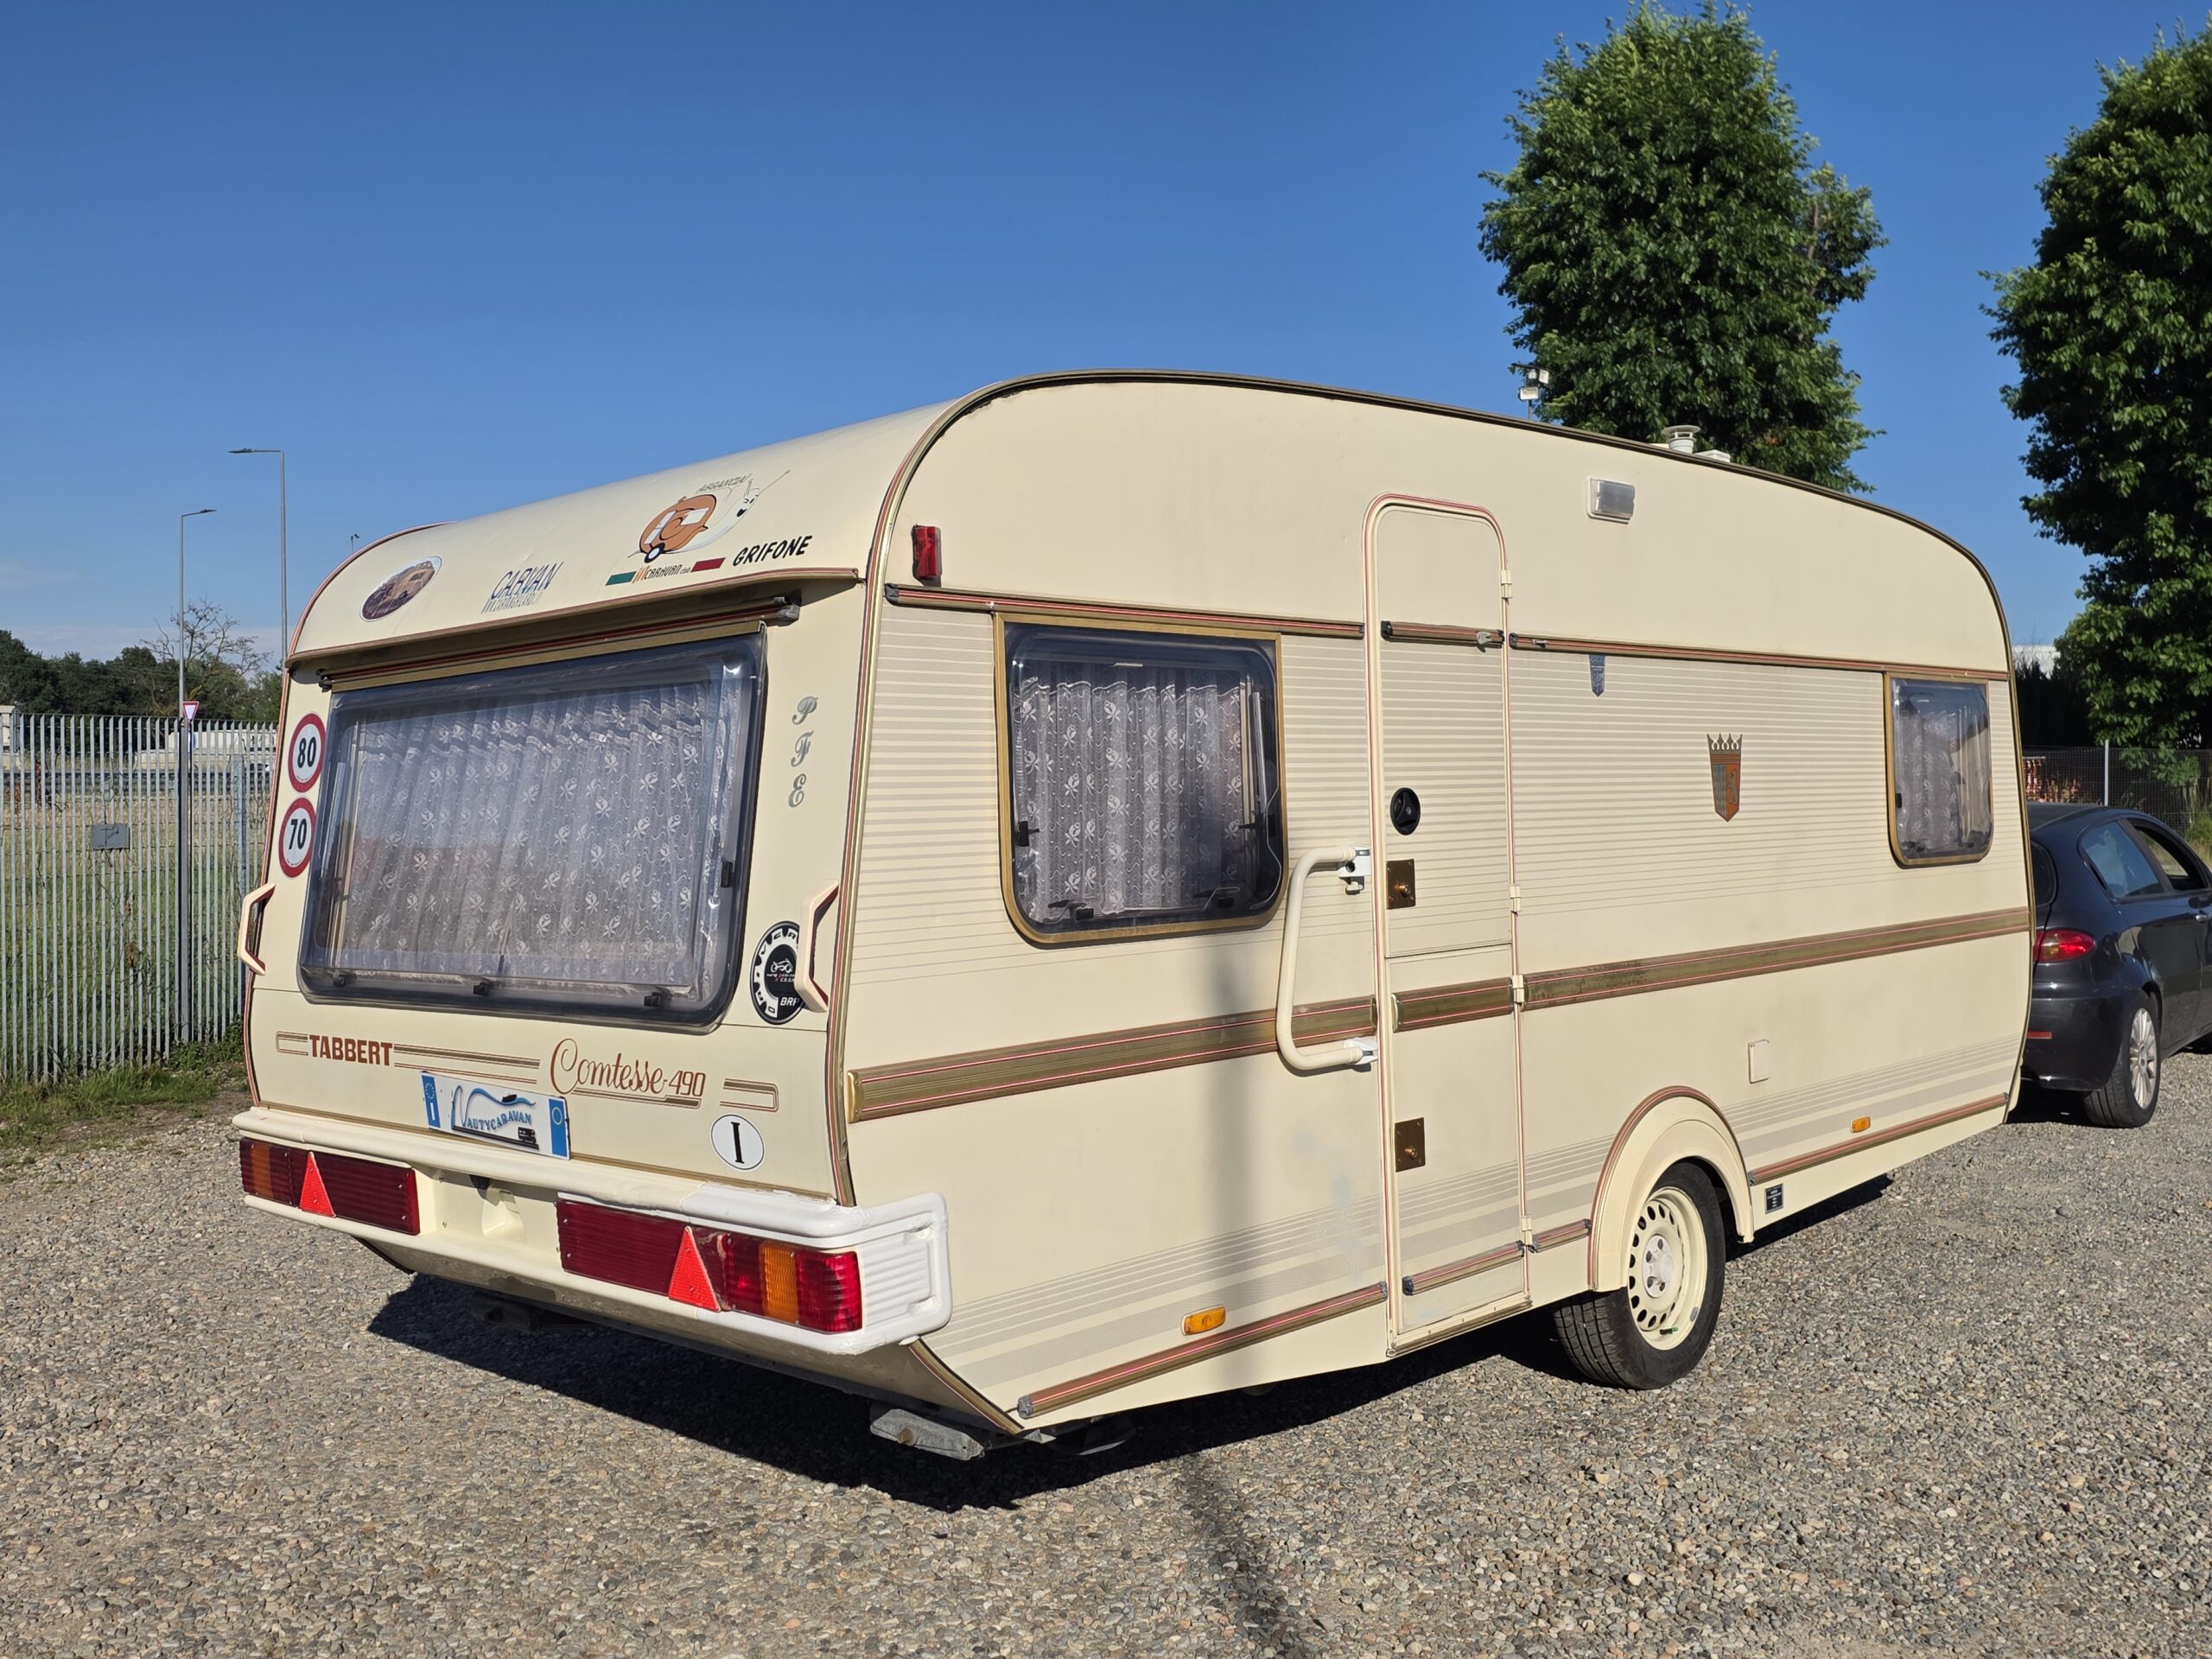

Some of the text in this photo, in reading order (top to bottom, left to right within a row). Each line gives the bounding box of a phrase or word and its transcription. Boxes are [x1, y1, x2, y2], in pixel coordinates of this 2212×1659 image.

[732, 535, 813, 567] GRIFONE
[297, 735, 317, 769] 80
[288, 818, 308, 850] 70
[308, 1033, 393, 1067] TABBERT
[668, 1070, 707, 1097] 490
[730, 1121, 745, 1165] I
